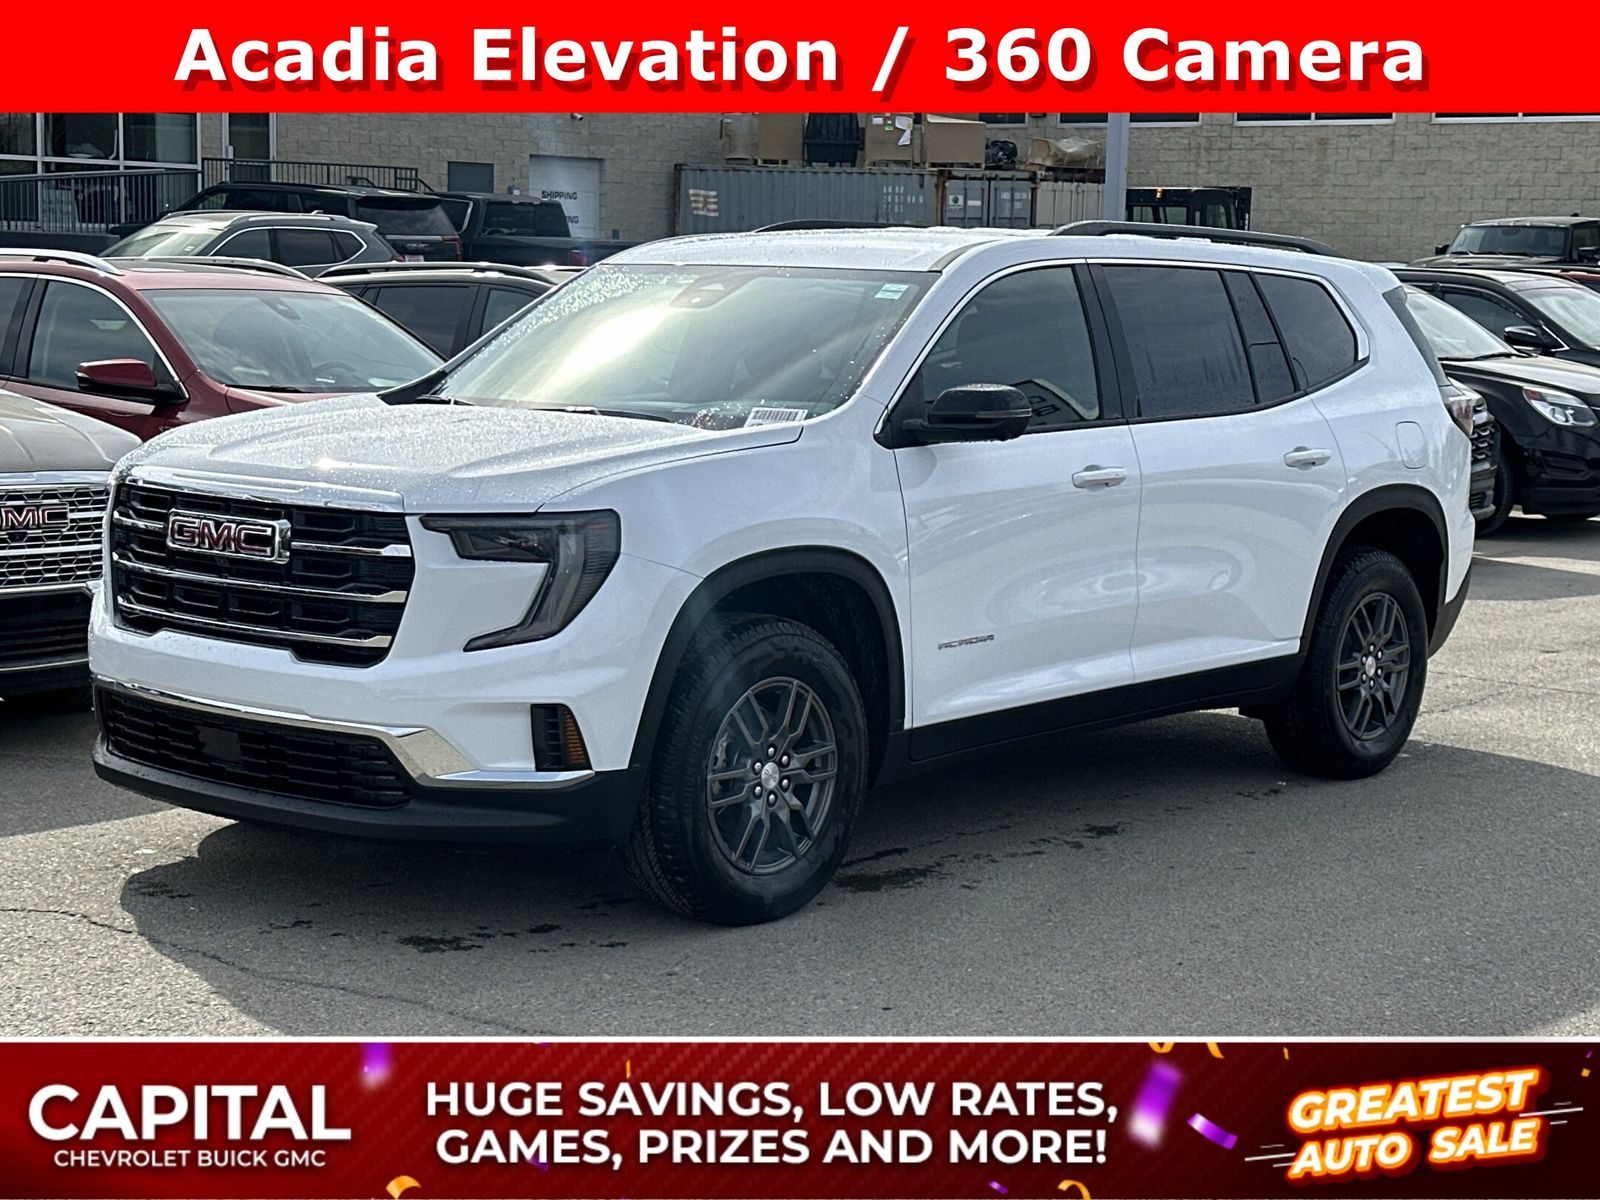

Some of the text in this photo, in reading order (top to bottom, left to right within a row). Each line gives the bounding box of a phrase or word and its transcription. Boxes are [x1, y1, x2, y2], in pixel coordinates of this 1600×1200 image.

[541, 190, 578, 200] SHIPPING
[0, 504, 70, 530] MC
[168, 515, 274, 557] GMC
